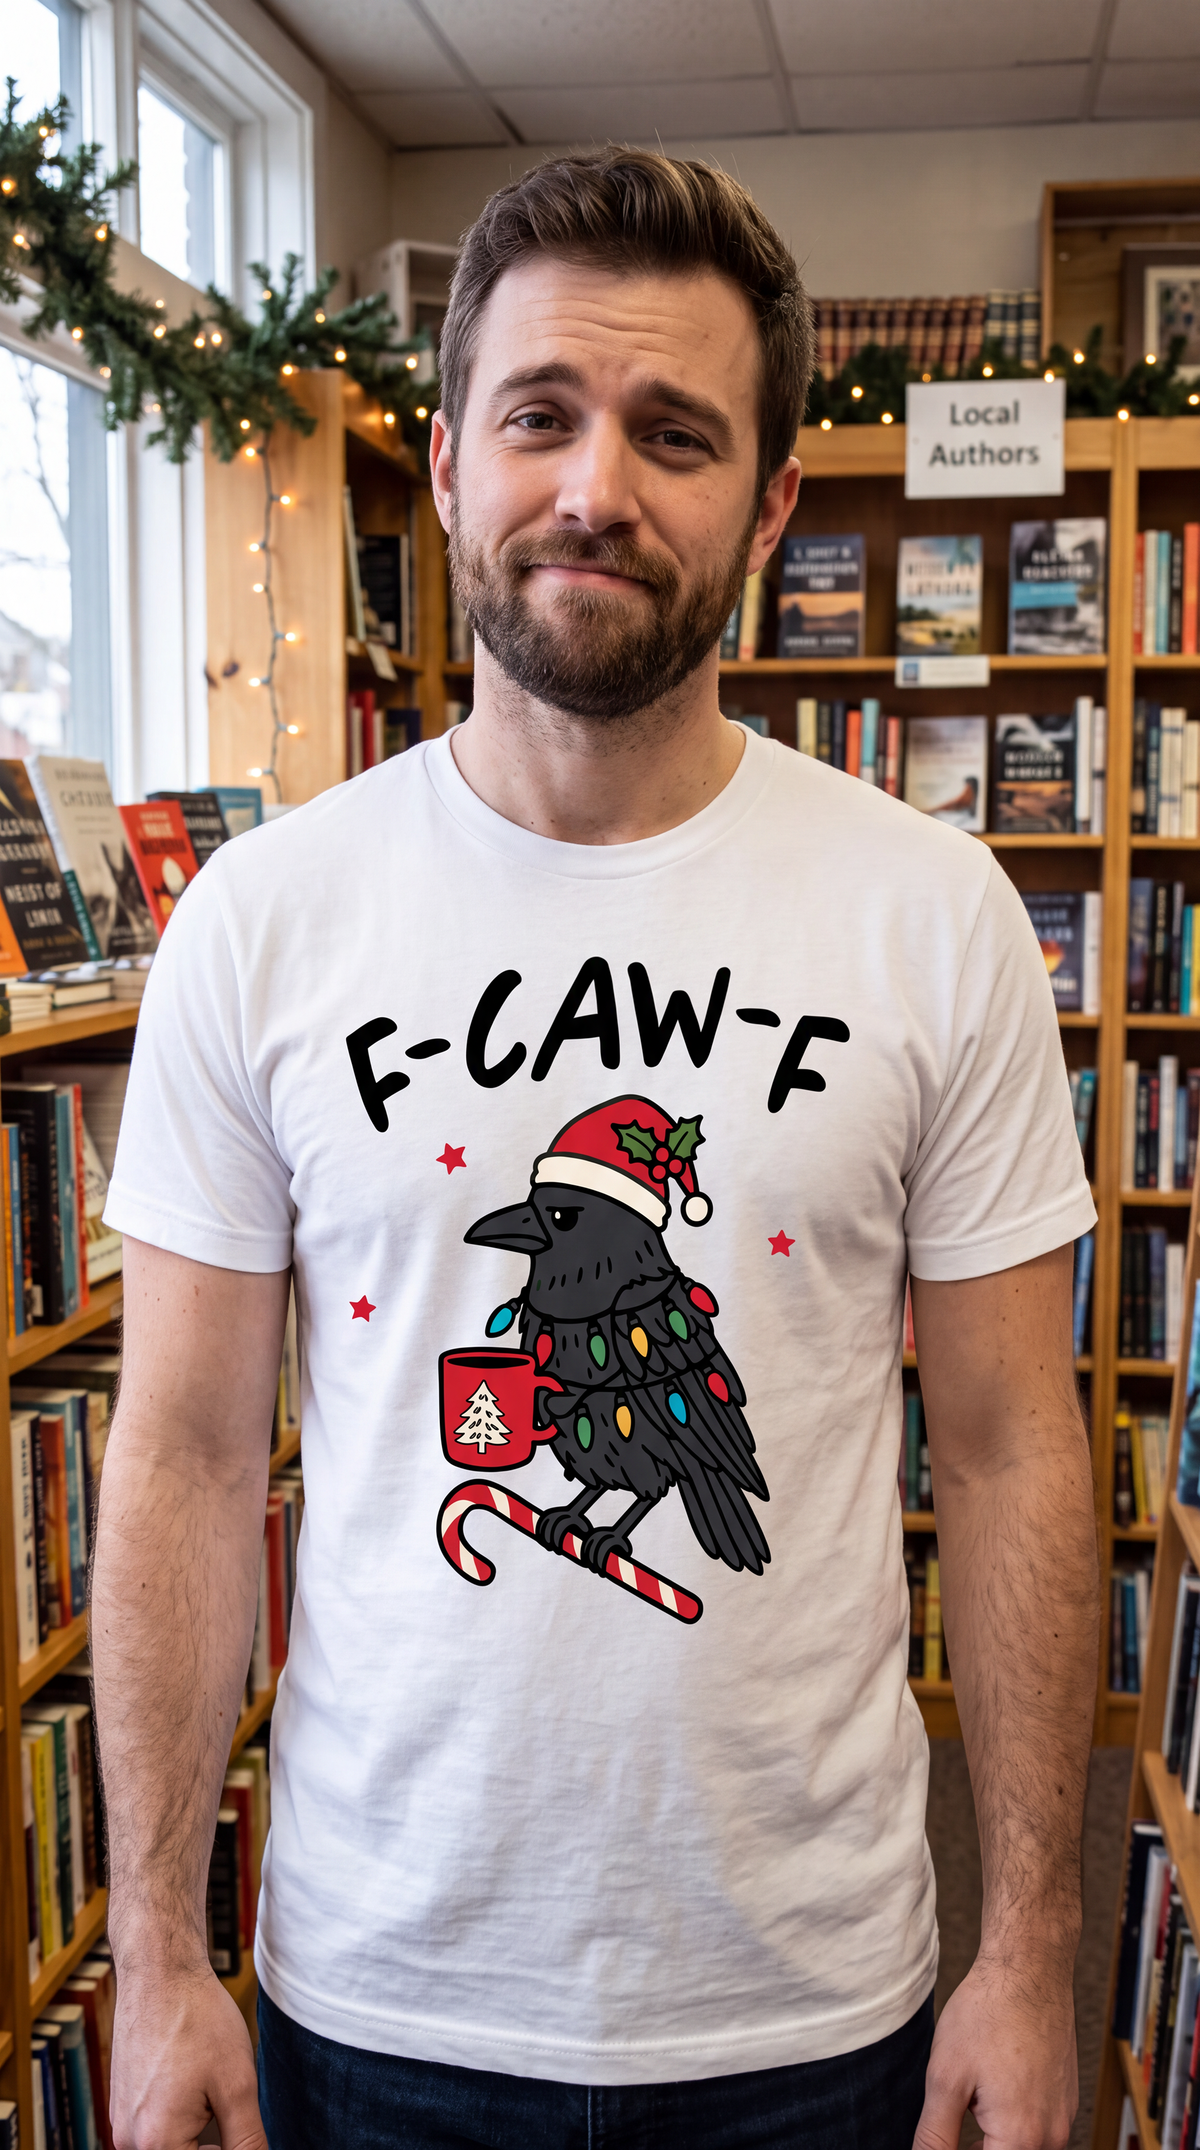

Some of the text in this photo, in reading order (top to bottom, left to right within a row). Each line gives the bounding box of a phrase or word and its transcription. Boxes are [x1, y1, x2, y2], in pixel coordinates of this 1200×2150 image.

[950, 400, 1020, 427] Local
[929, 441, 1040, 468] Authors
[346, 956, 850, 1132] F-CAW-F
